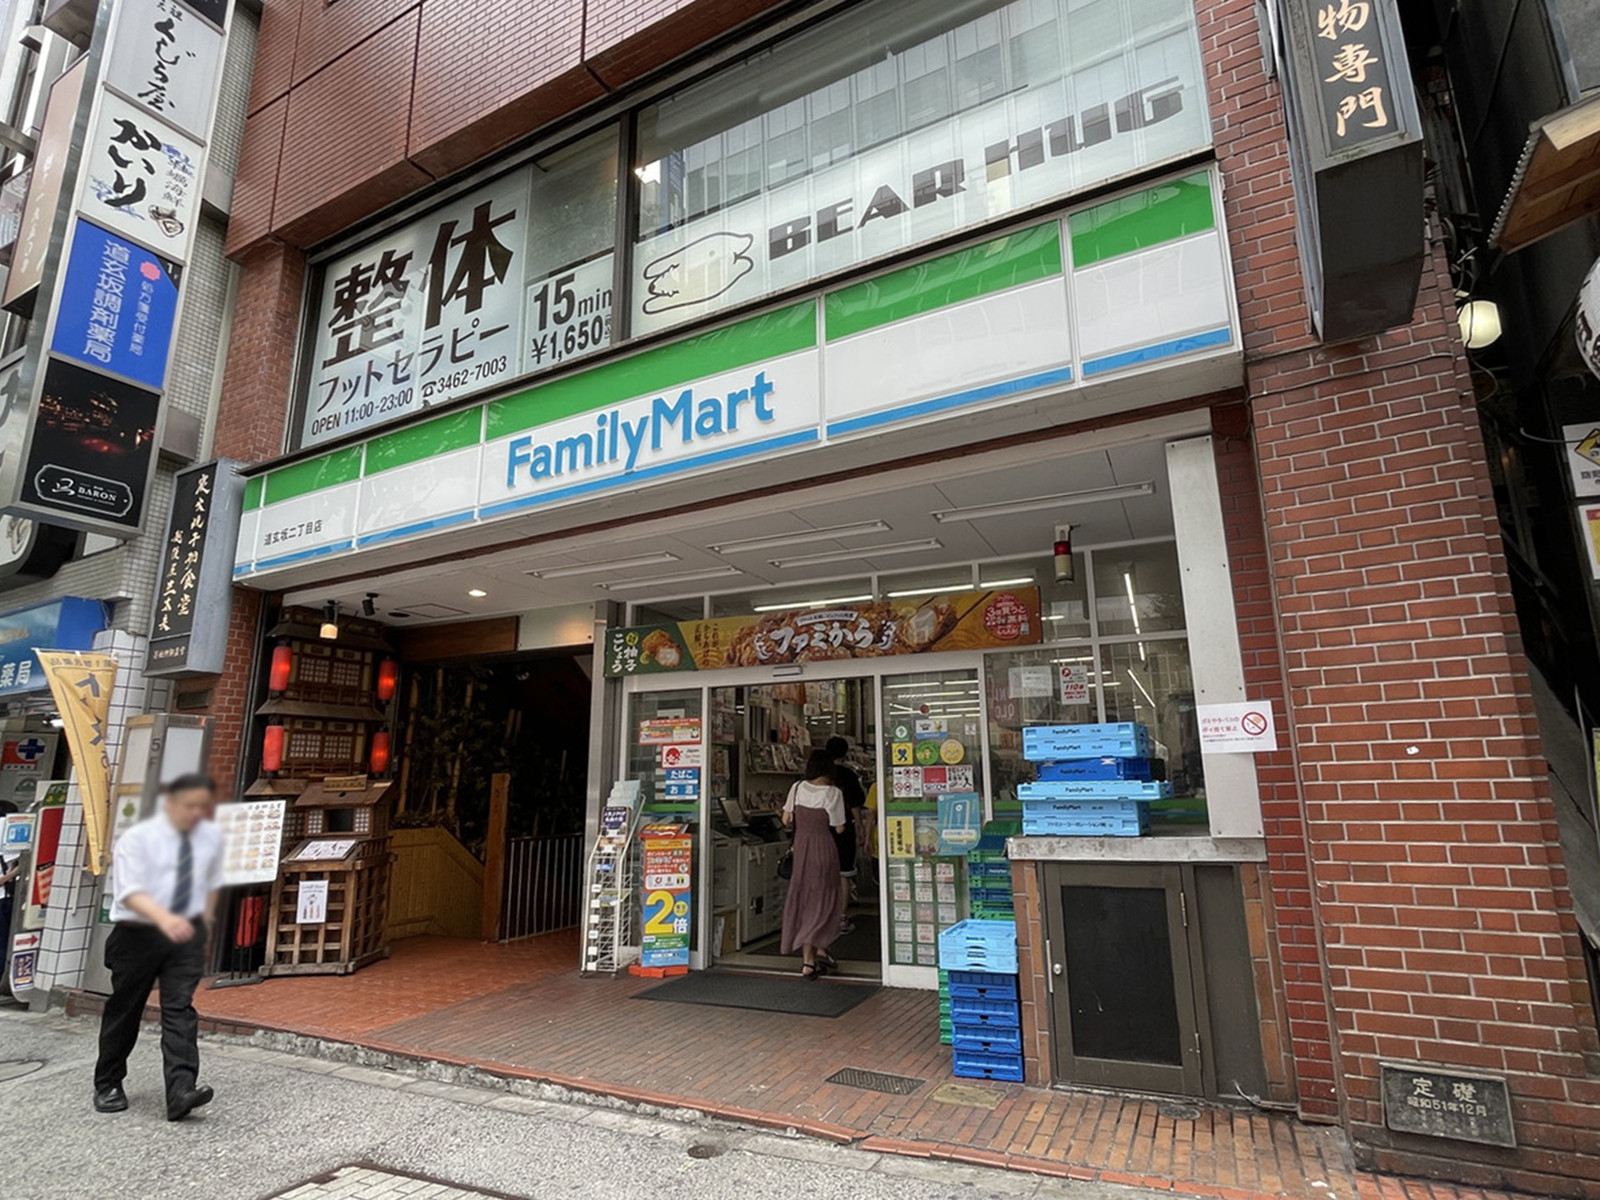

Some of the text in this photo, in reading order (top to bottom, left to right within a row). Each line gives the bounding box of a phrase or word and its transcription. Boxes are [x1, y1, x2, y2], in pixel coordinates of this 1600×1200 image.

[768, 76, 1185, 262] BEAR HUG
[82, 238, 132, 363] 道玄坂調剤薬局
[321, 199, 517, 371] 整体
[317, 317, 510, 412] フットセラピー
[311, 387, 414, 436] OPEN 11:00-23:00
[506, 371, 775, 488] FamilyMart
[78, 486, 117, 501] BARON
[611, 632, 625, 673] こしょう
[769, 617, 874, 655] ファミから
[670, 769, 694, 780] たばこ
